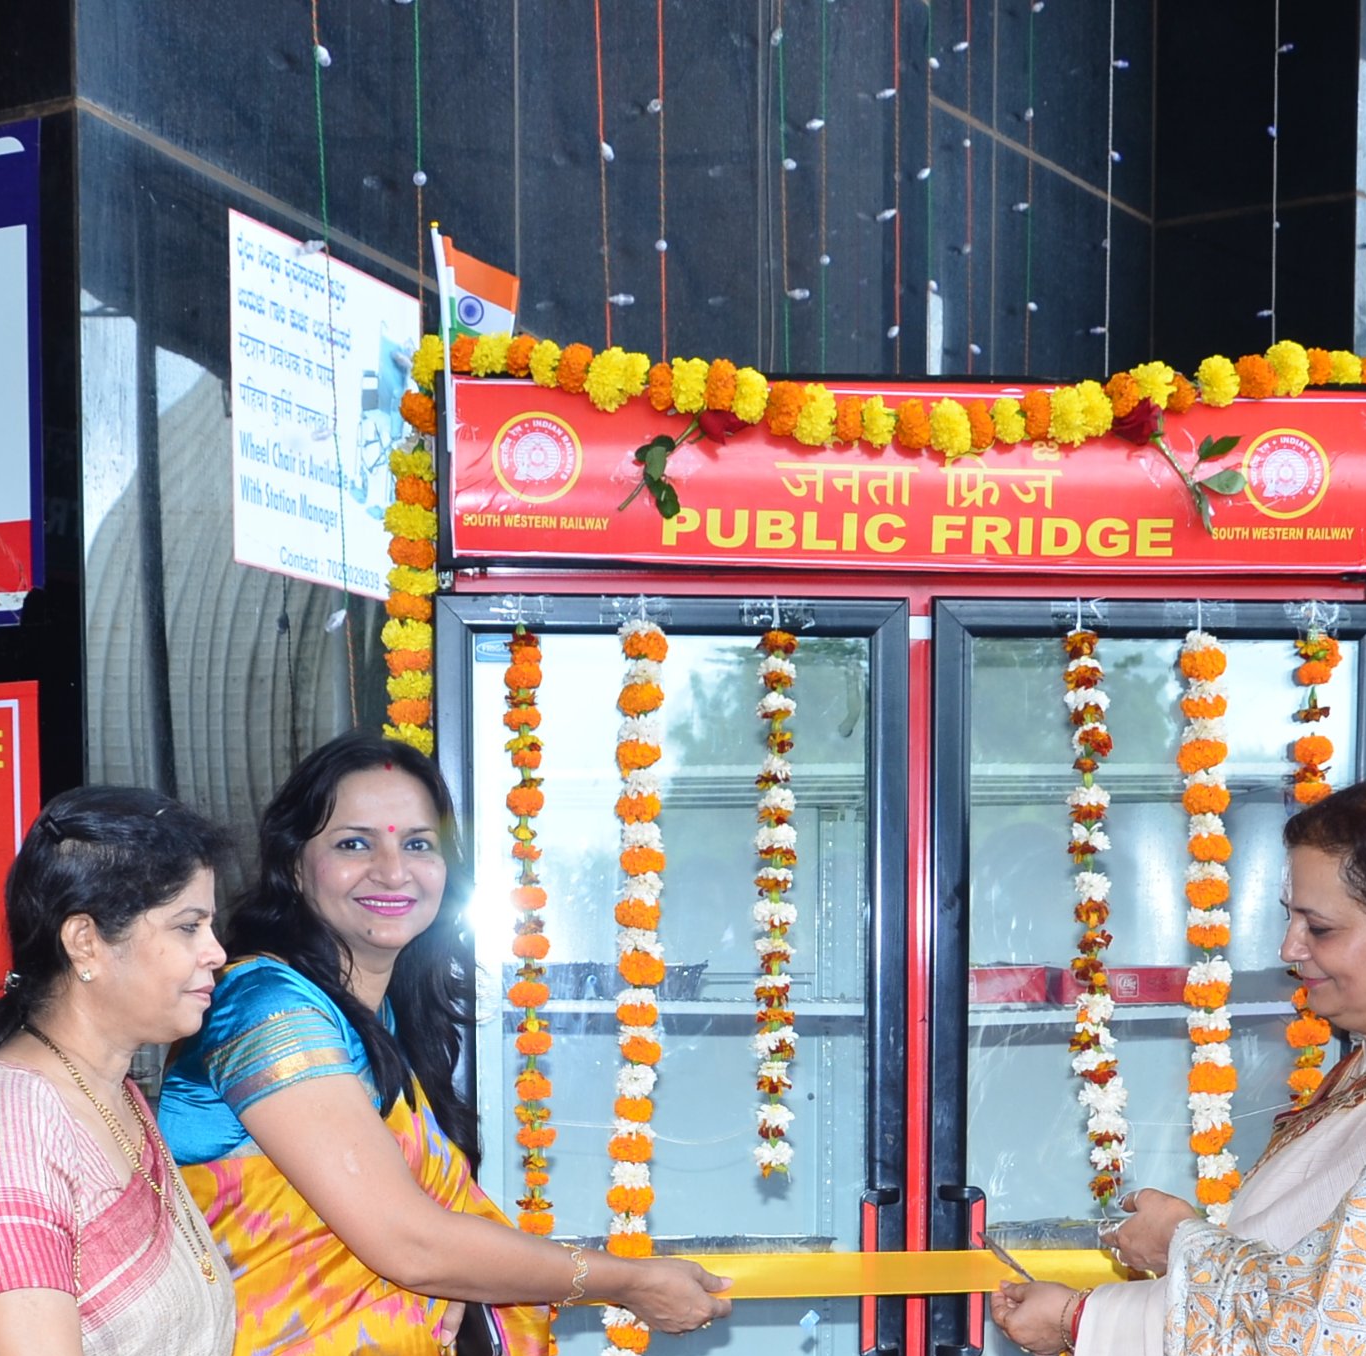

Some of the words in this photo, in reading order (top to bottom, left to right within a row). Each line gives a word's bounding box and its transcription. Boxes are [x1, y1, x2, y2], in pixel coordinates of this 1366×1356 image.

[239, 430, 270, 465] Wheel
[272, 442, 296, 474] Chair
[298, 452, 306, 477] is
[532, 419, 564, 437] INDIAN
[560, 434, 575, 481] RAILWAYS
[1280, 436, 1310, 453] INDIAN
[1307, 449, 1322, 496] RAILWAYS
[240, 474, 263, 506] With
[265, 482, 297, 516] Station
[299, 492, 339, 533] Manager
[774, 461, 920, 508] जनता
[939, 454, 1064, 510] फ्रिज
[462, 513, 501, 527] SOUTH
[503, 514, 557, 529] WESTERN
[560, 516, 610, 531] RAILWAY
[661, 507, 907, 554] PUBLIC
[931, 514, 1174, 557] FRIDGE
[1212, 526, 1250, 540] SOUTH
[1252, 527, 1304, 540] WESTERN
[1306, 527, 1355, 540] RAILWAY
[279, 546, 318, 574] Contact
